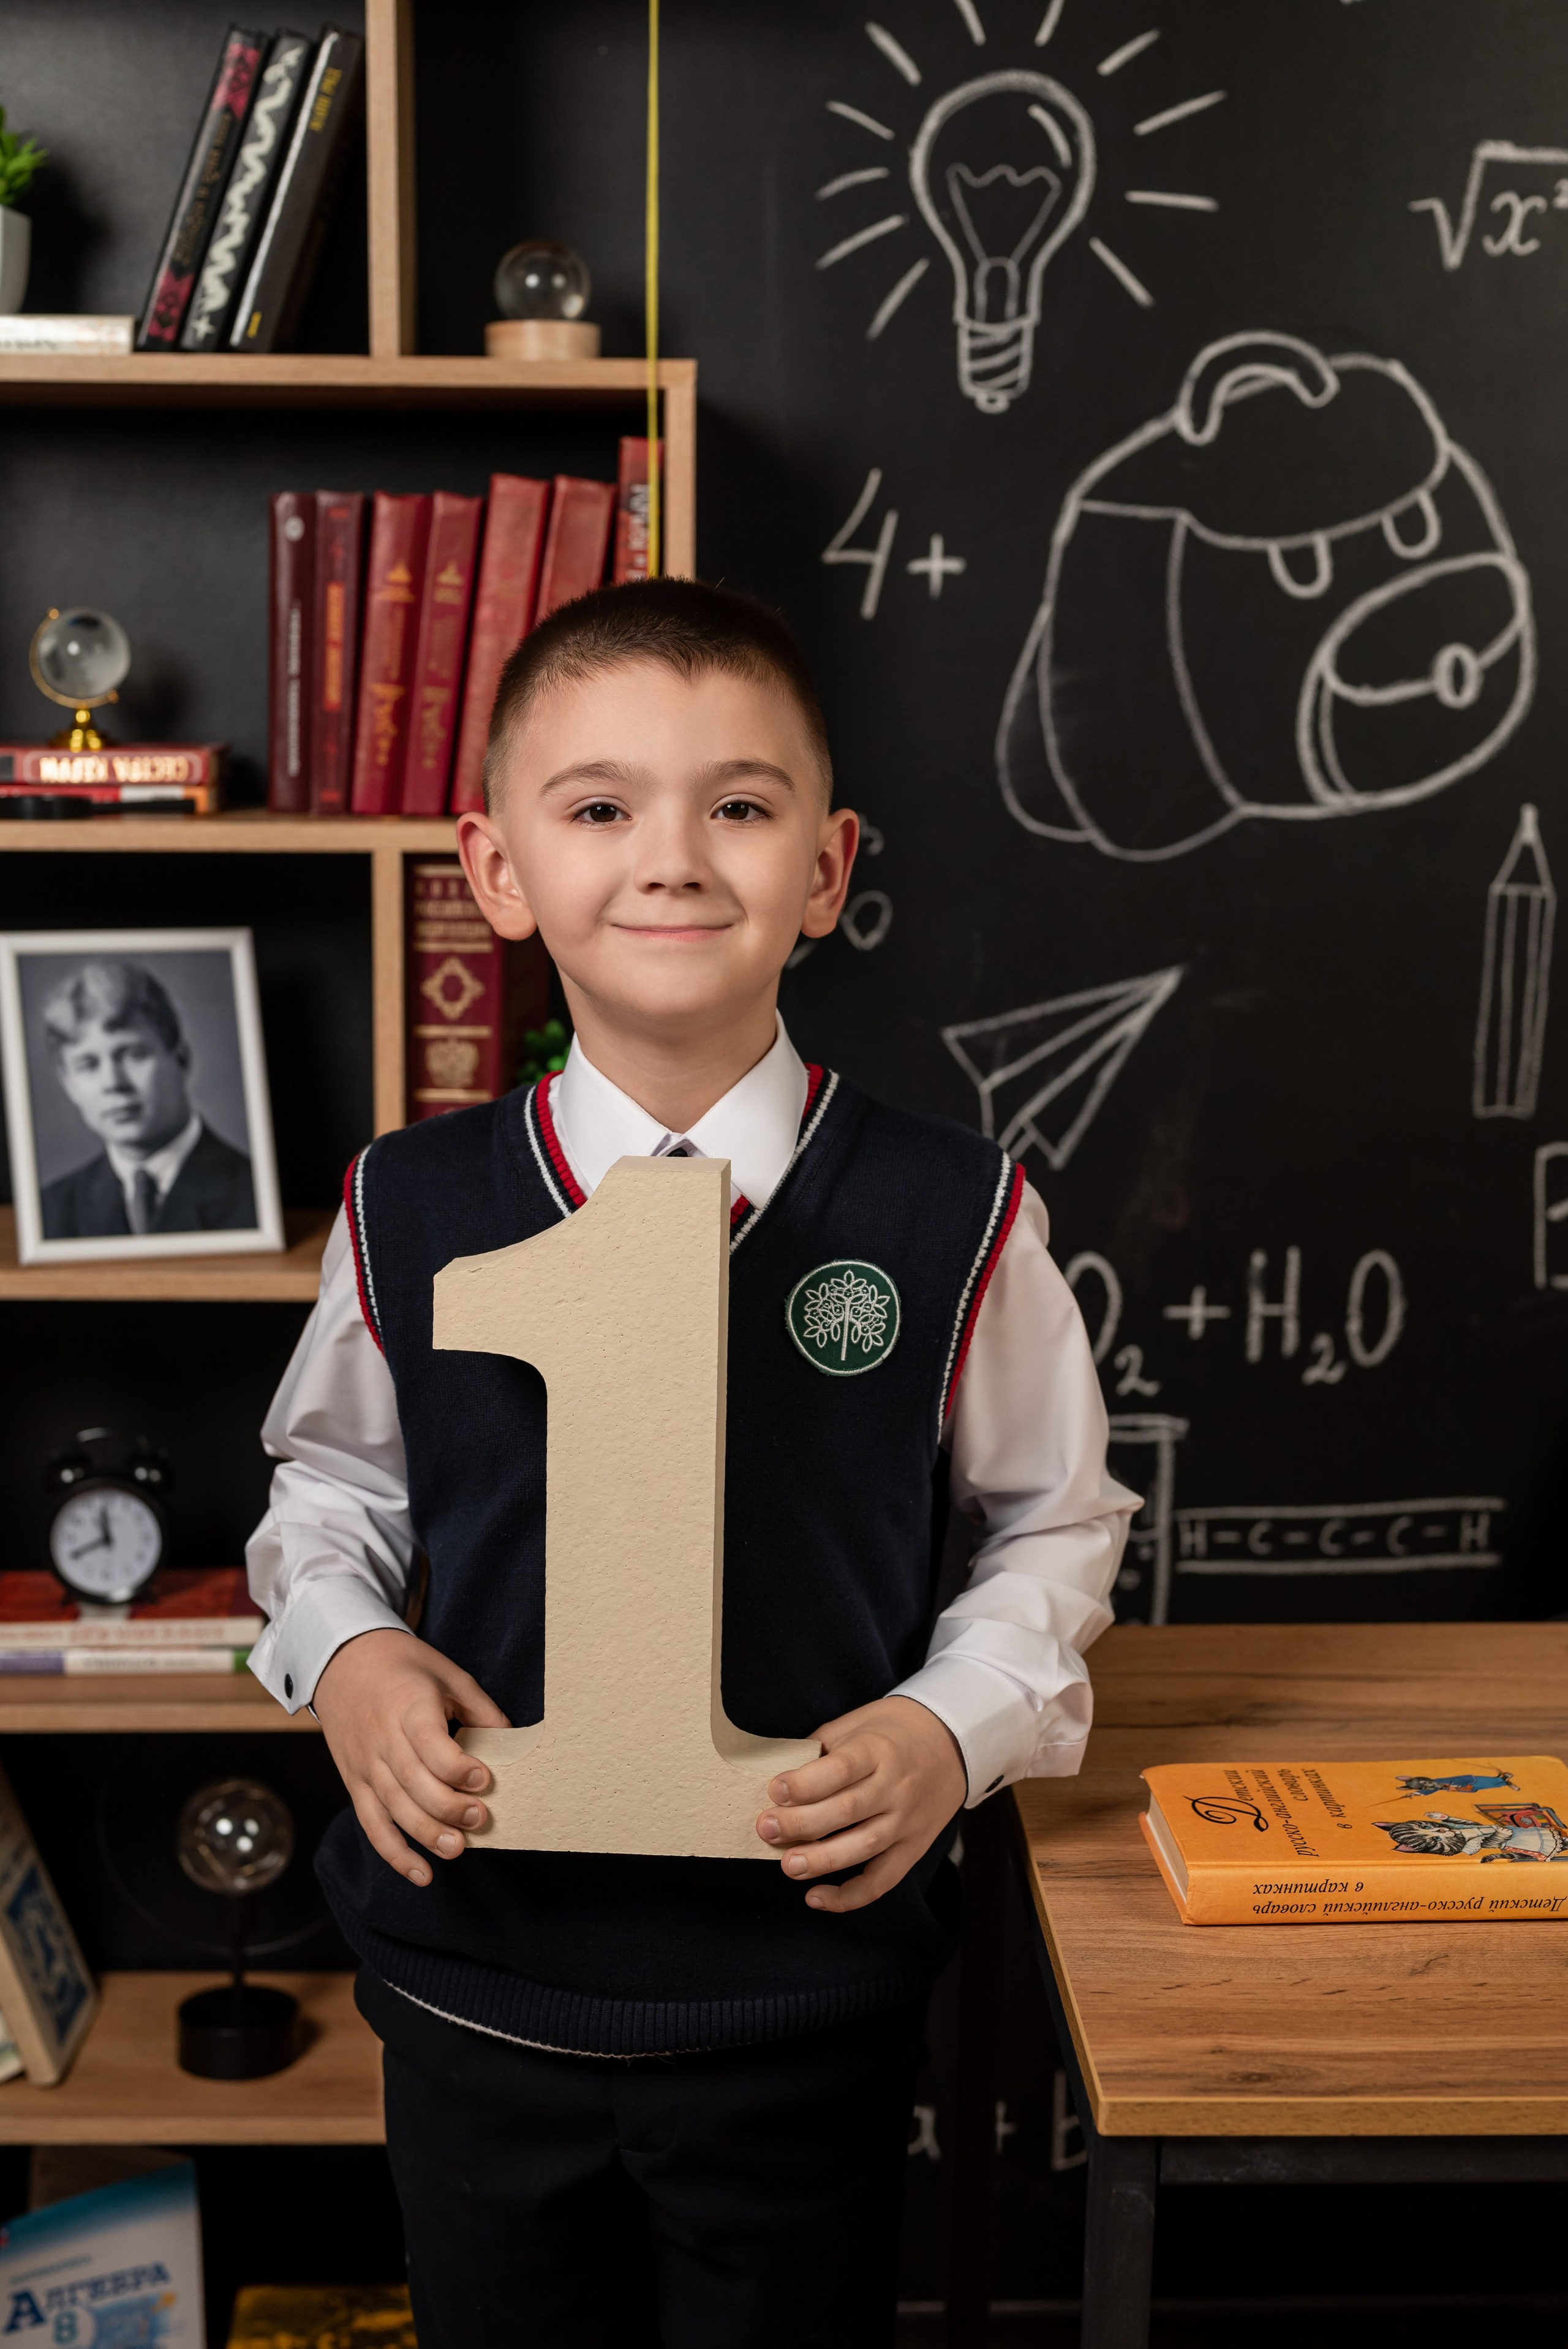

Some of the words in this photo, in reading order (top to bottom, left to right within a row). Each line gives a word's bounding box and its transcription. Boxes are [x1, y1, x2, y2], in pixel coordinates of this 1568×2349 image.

[1277, 1768, 1308, 1801] словарь
[1302, 1768, 1346, 1818] картинках
[1253, 1878, 1349, 1894] картинках
[1354, 1882, 1364, 1892] в
[1253, 1901, 1316, 1914] словарь
[1322, 1896, 1485, 1916] русско-английский
[1488, 1896, 1567, 1913] Детский
